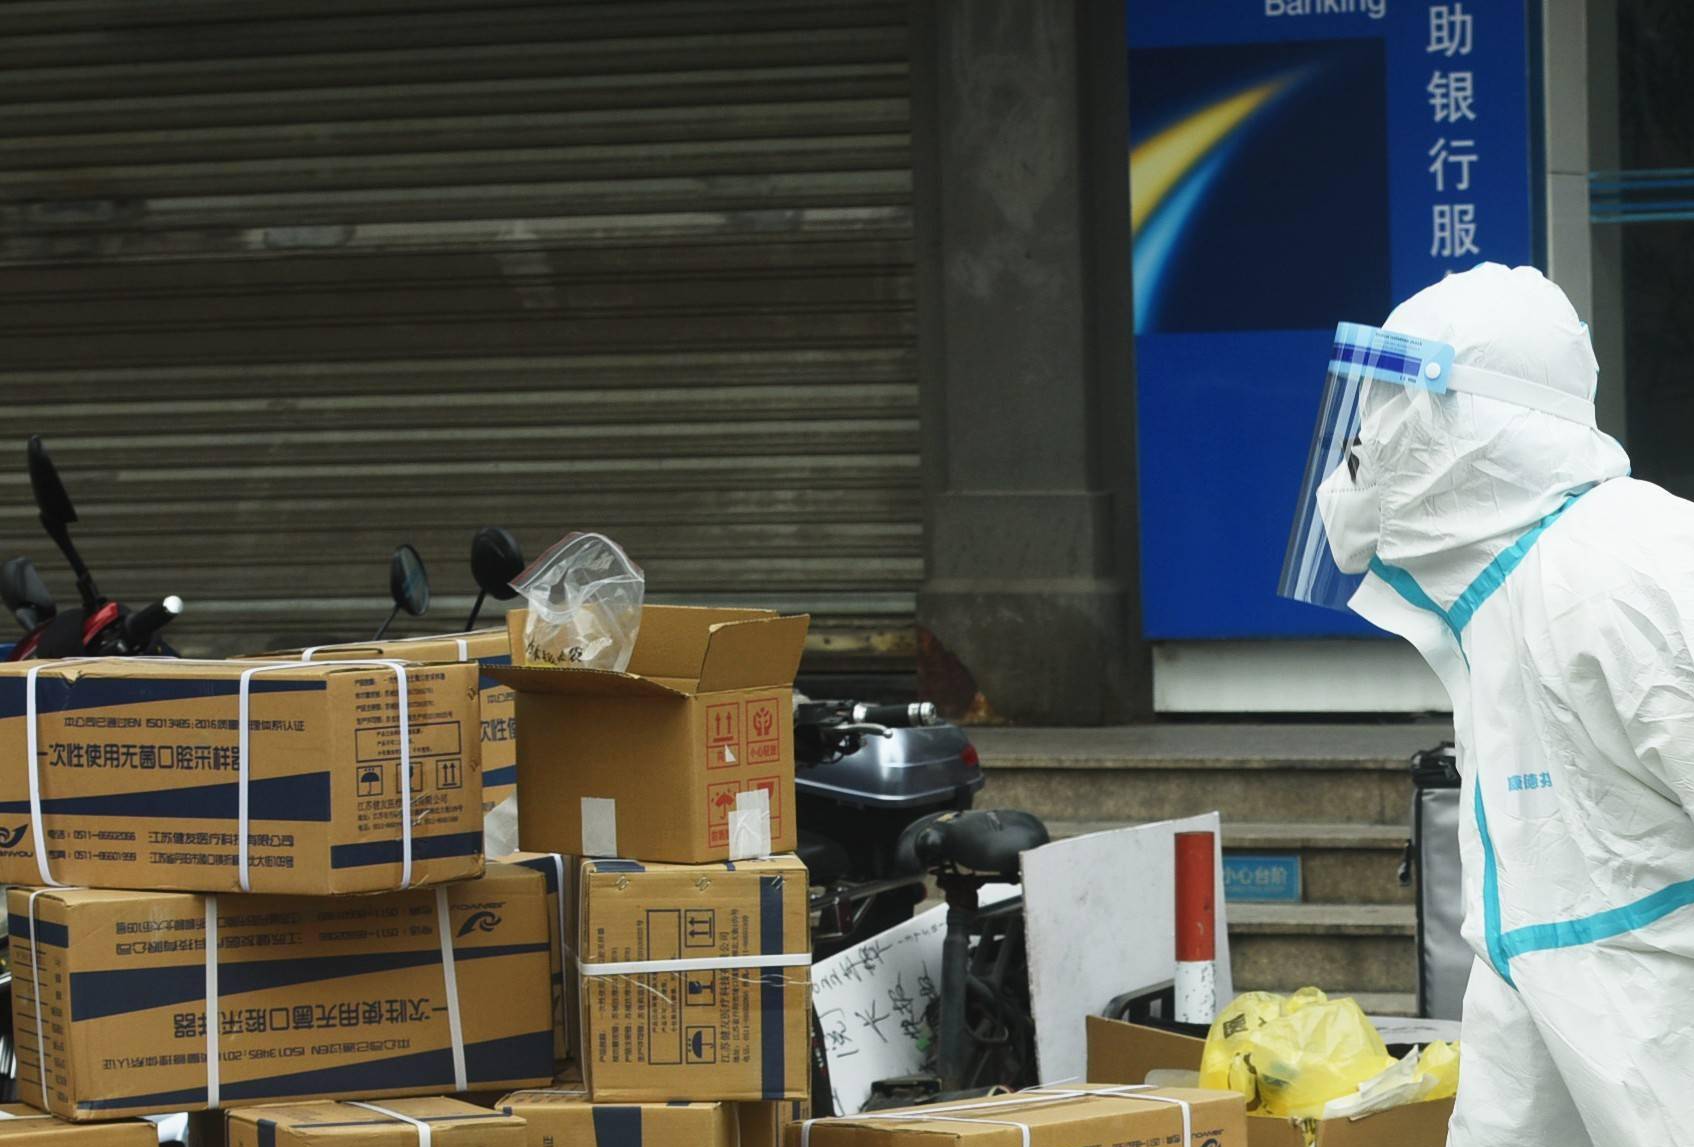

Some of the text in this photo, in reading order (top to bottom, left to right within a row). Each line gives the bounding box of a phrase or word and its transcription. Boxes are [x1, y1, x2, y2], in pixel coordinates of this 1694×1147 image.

[1264, 0, 1387, 19] Banking
[1427, 3, 1480, 276] 助银行服
[146, 718, 305, 732] ISO13485:2016质量理体系认证
